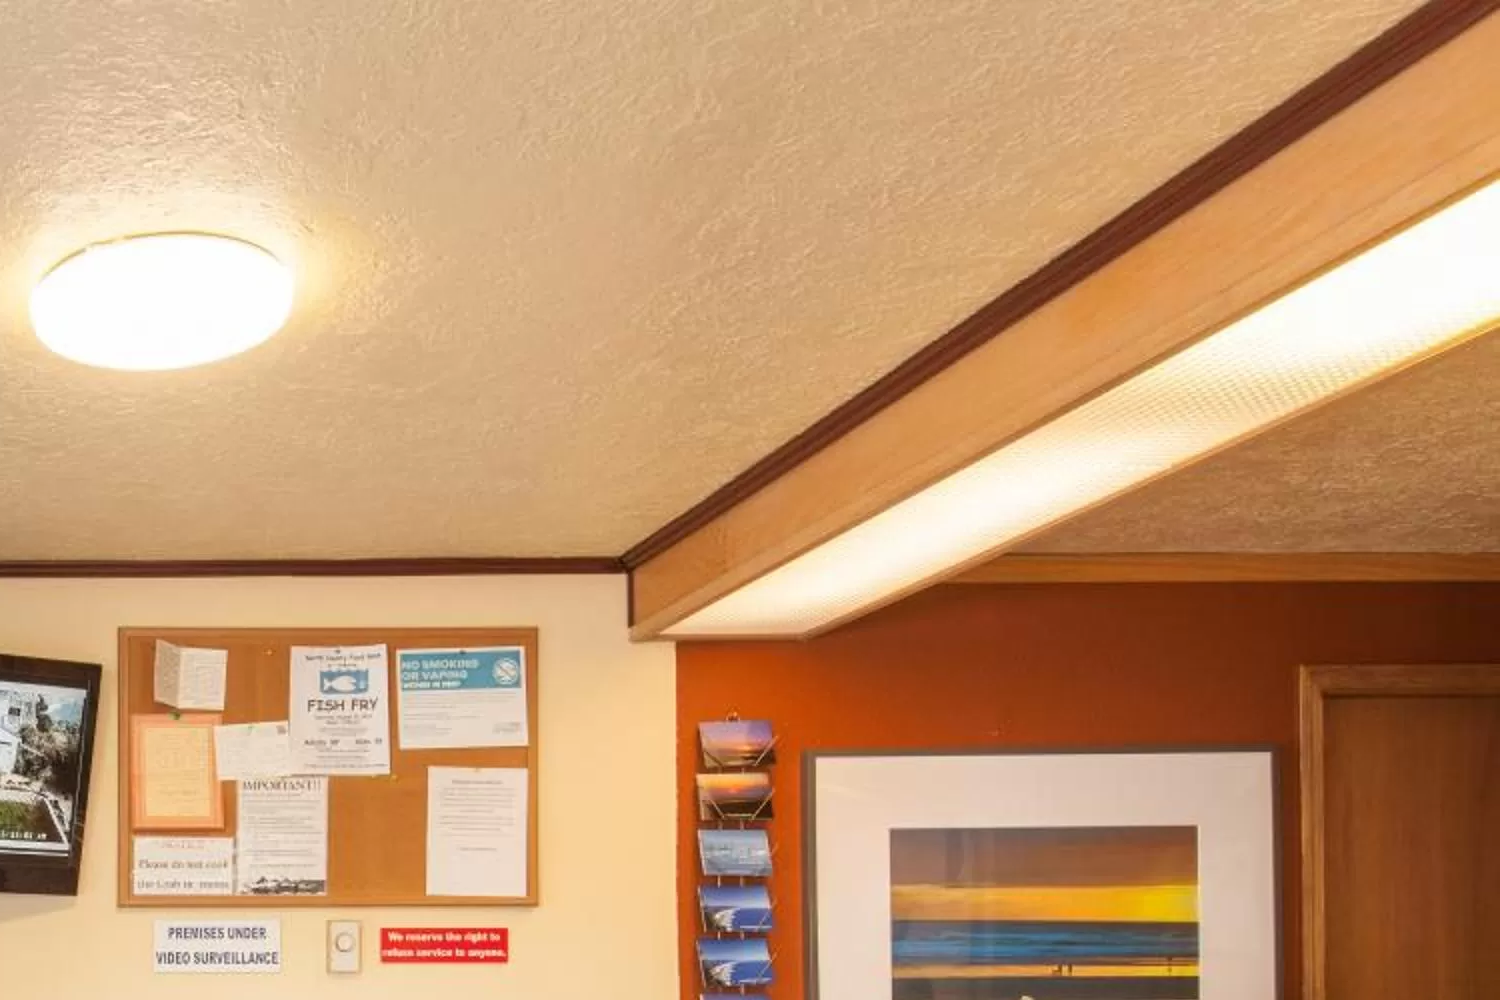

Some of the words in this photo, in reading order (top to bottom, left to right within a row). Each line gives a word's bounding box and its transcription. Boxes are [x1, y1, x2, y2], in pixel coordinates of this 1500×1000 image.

[307, 699, 345, 712] FISH
[351, 697, 379, 711] FRY
[167, 927, 225, 940] PREMISES
[227, 927, 267, 940] UNDER
[388, 932, 404, 942] We
[405, 933, 443, 942] reserve
[445, 932, 463, 942] the
[464, 932, 488, 944] right
[489, 933, 501, 942] to
[156, 951, 191, 965] VIDEO
[193, 951, 279, 965] SURVEILLANCE
[416, 948, 454, 957] service
[455, 949, 466, 958] to
